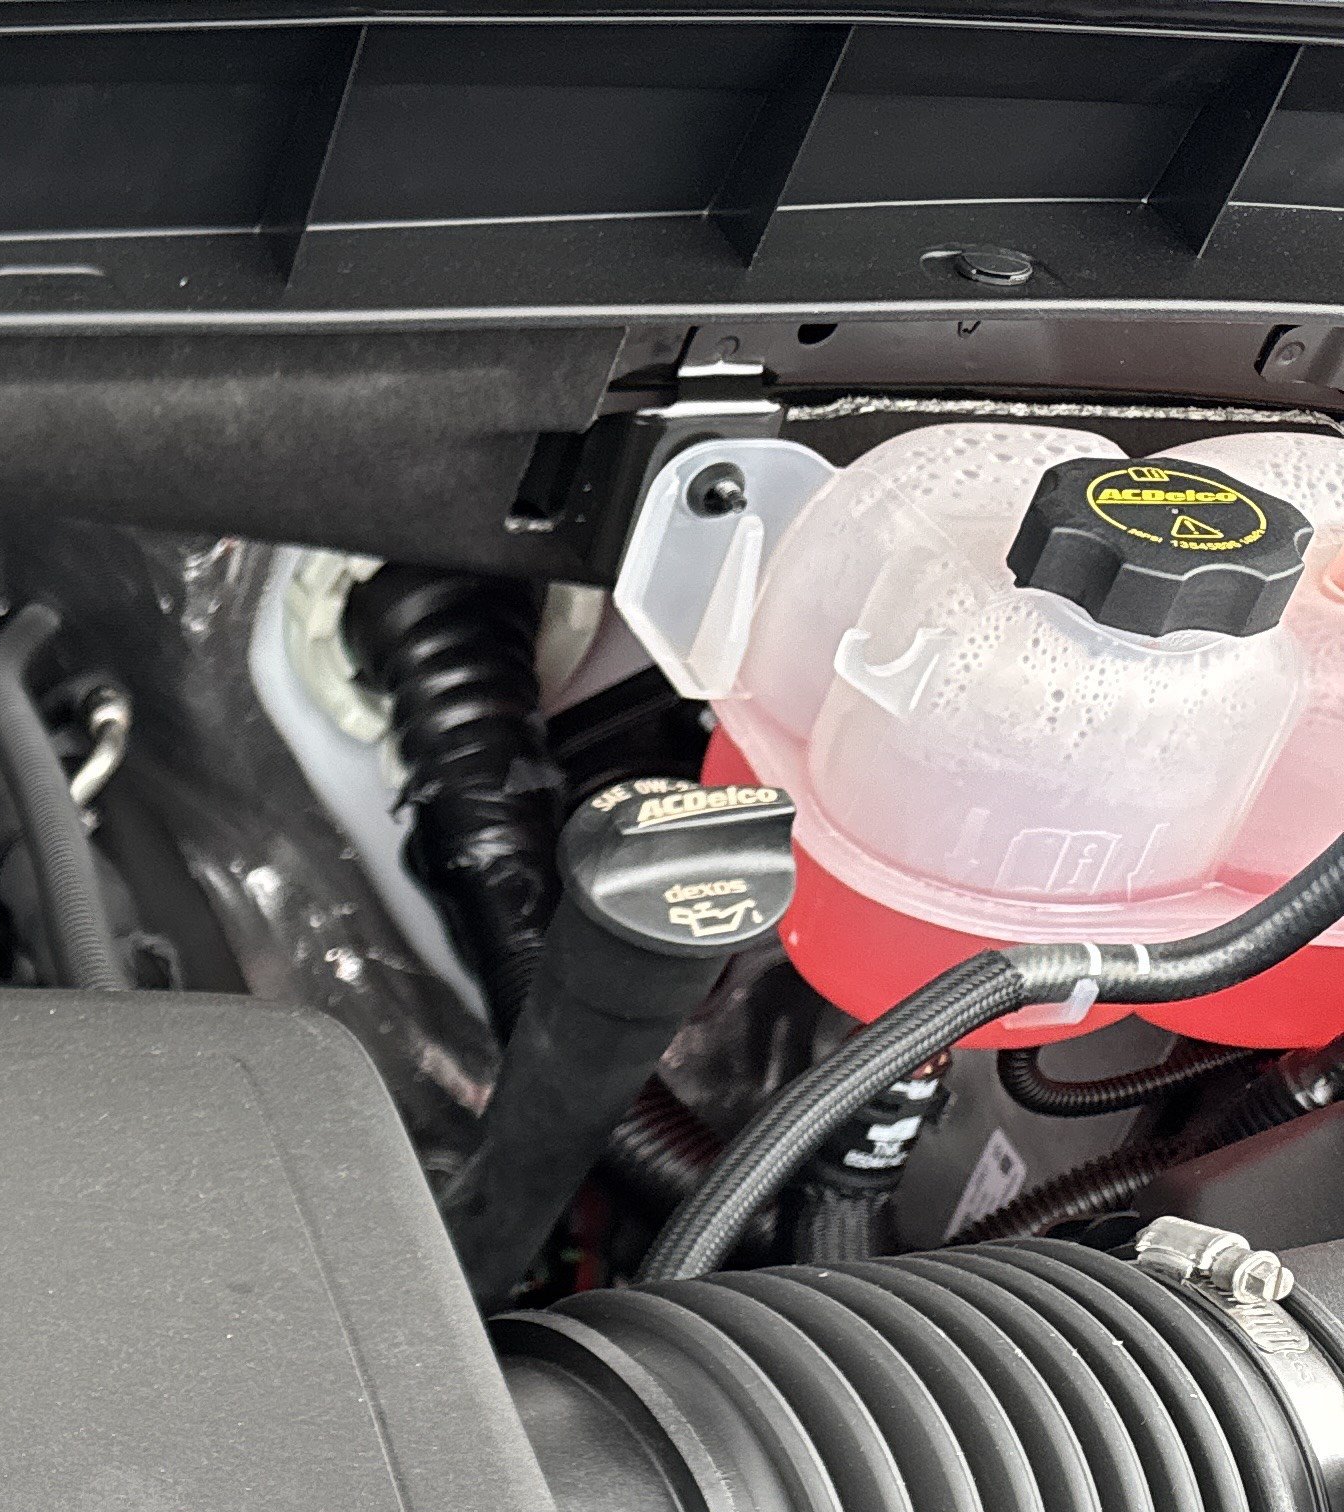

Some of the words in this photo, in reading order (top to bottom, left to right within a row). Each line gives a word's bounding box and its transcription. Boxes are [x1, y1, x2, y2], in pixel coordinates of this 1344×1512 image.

[1097, 488, 1238, 504] ACDelco
[591, 784, 632, 812] SAE
[633, 778, 703, 796] 0W-2
[636, 786, 779, 824] ACDelco
[664, 878, 748, 903] dexos
